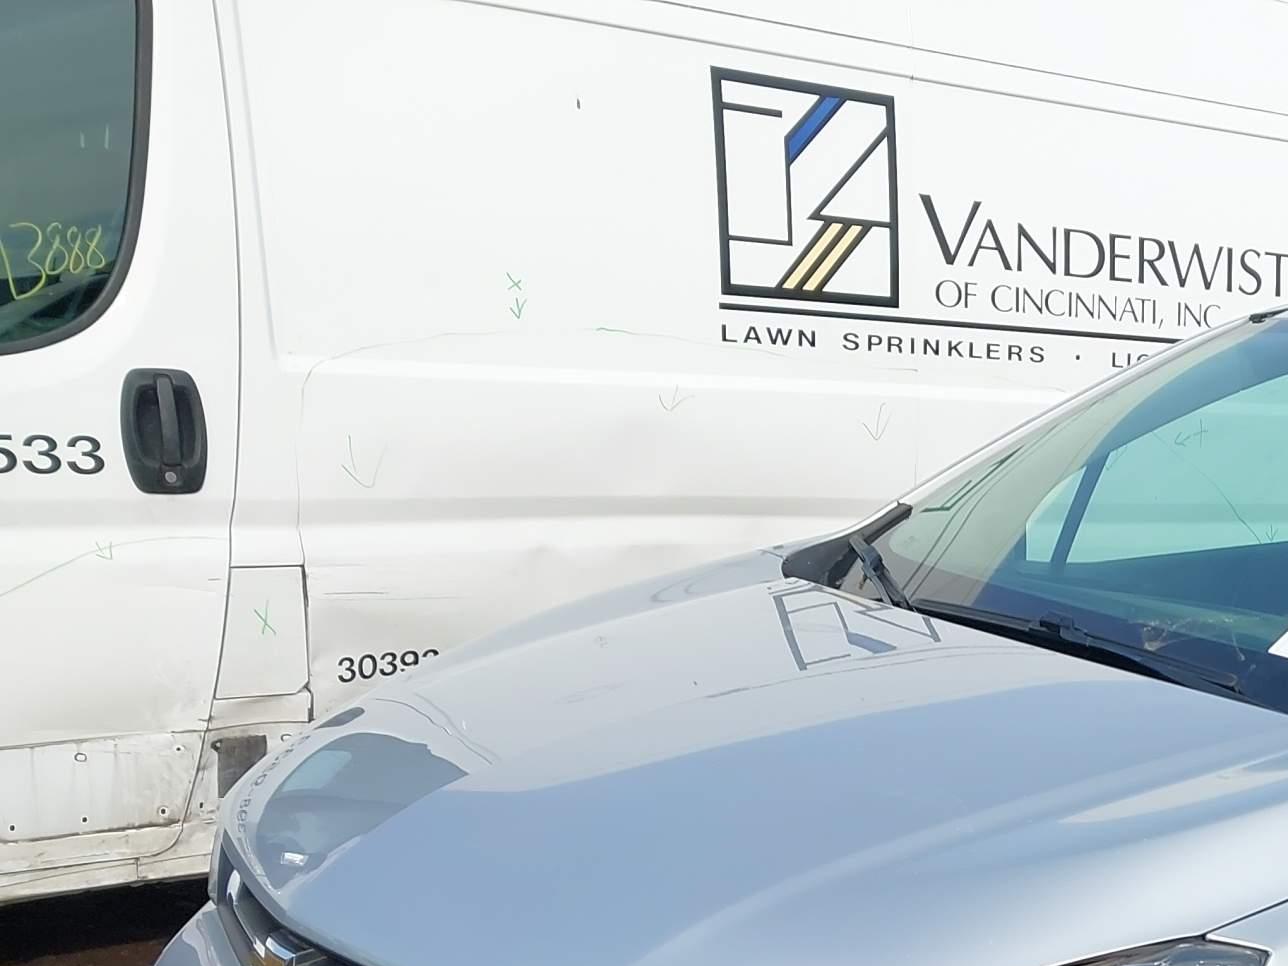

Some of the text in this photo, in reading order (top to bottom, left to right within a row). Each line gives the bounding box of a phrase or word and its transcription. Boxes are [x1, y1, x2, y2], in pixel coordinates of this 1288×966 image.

[935, 279, 979, 308] OF
[990, 285, 1164, 329] CINCINNATI,
[721, 324, 817, 348] LAWN
[842, 332, 1045, 363] SPRINKLERS
